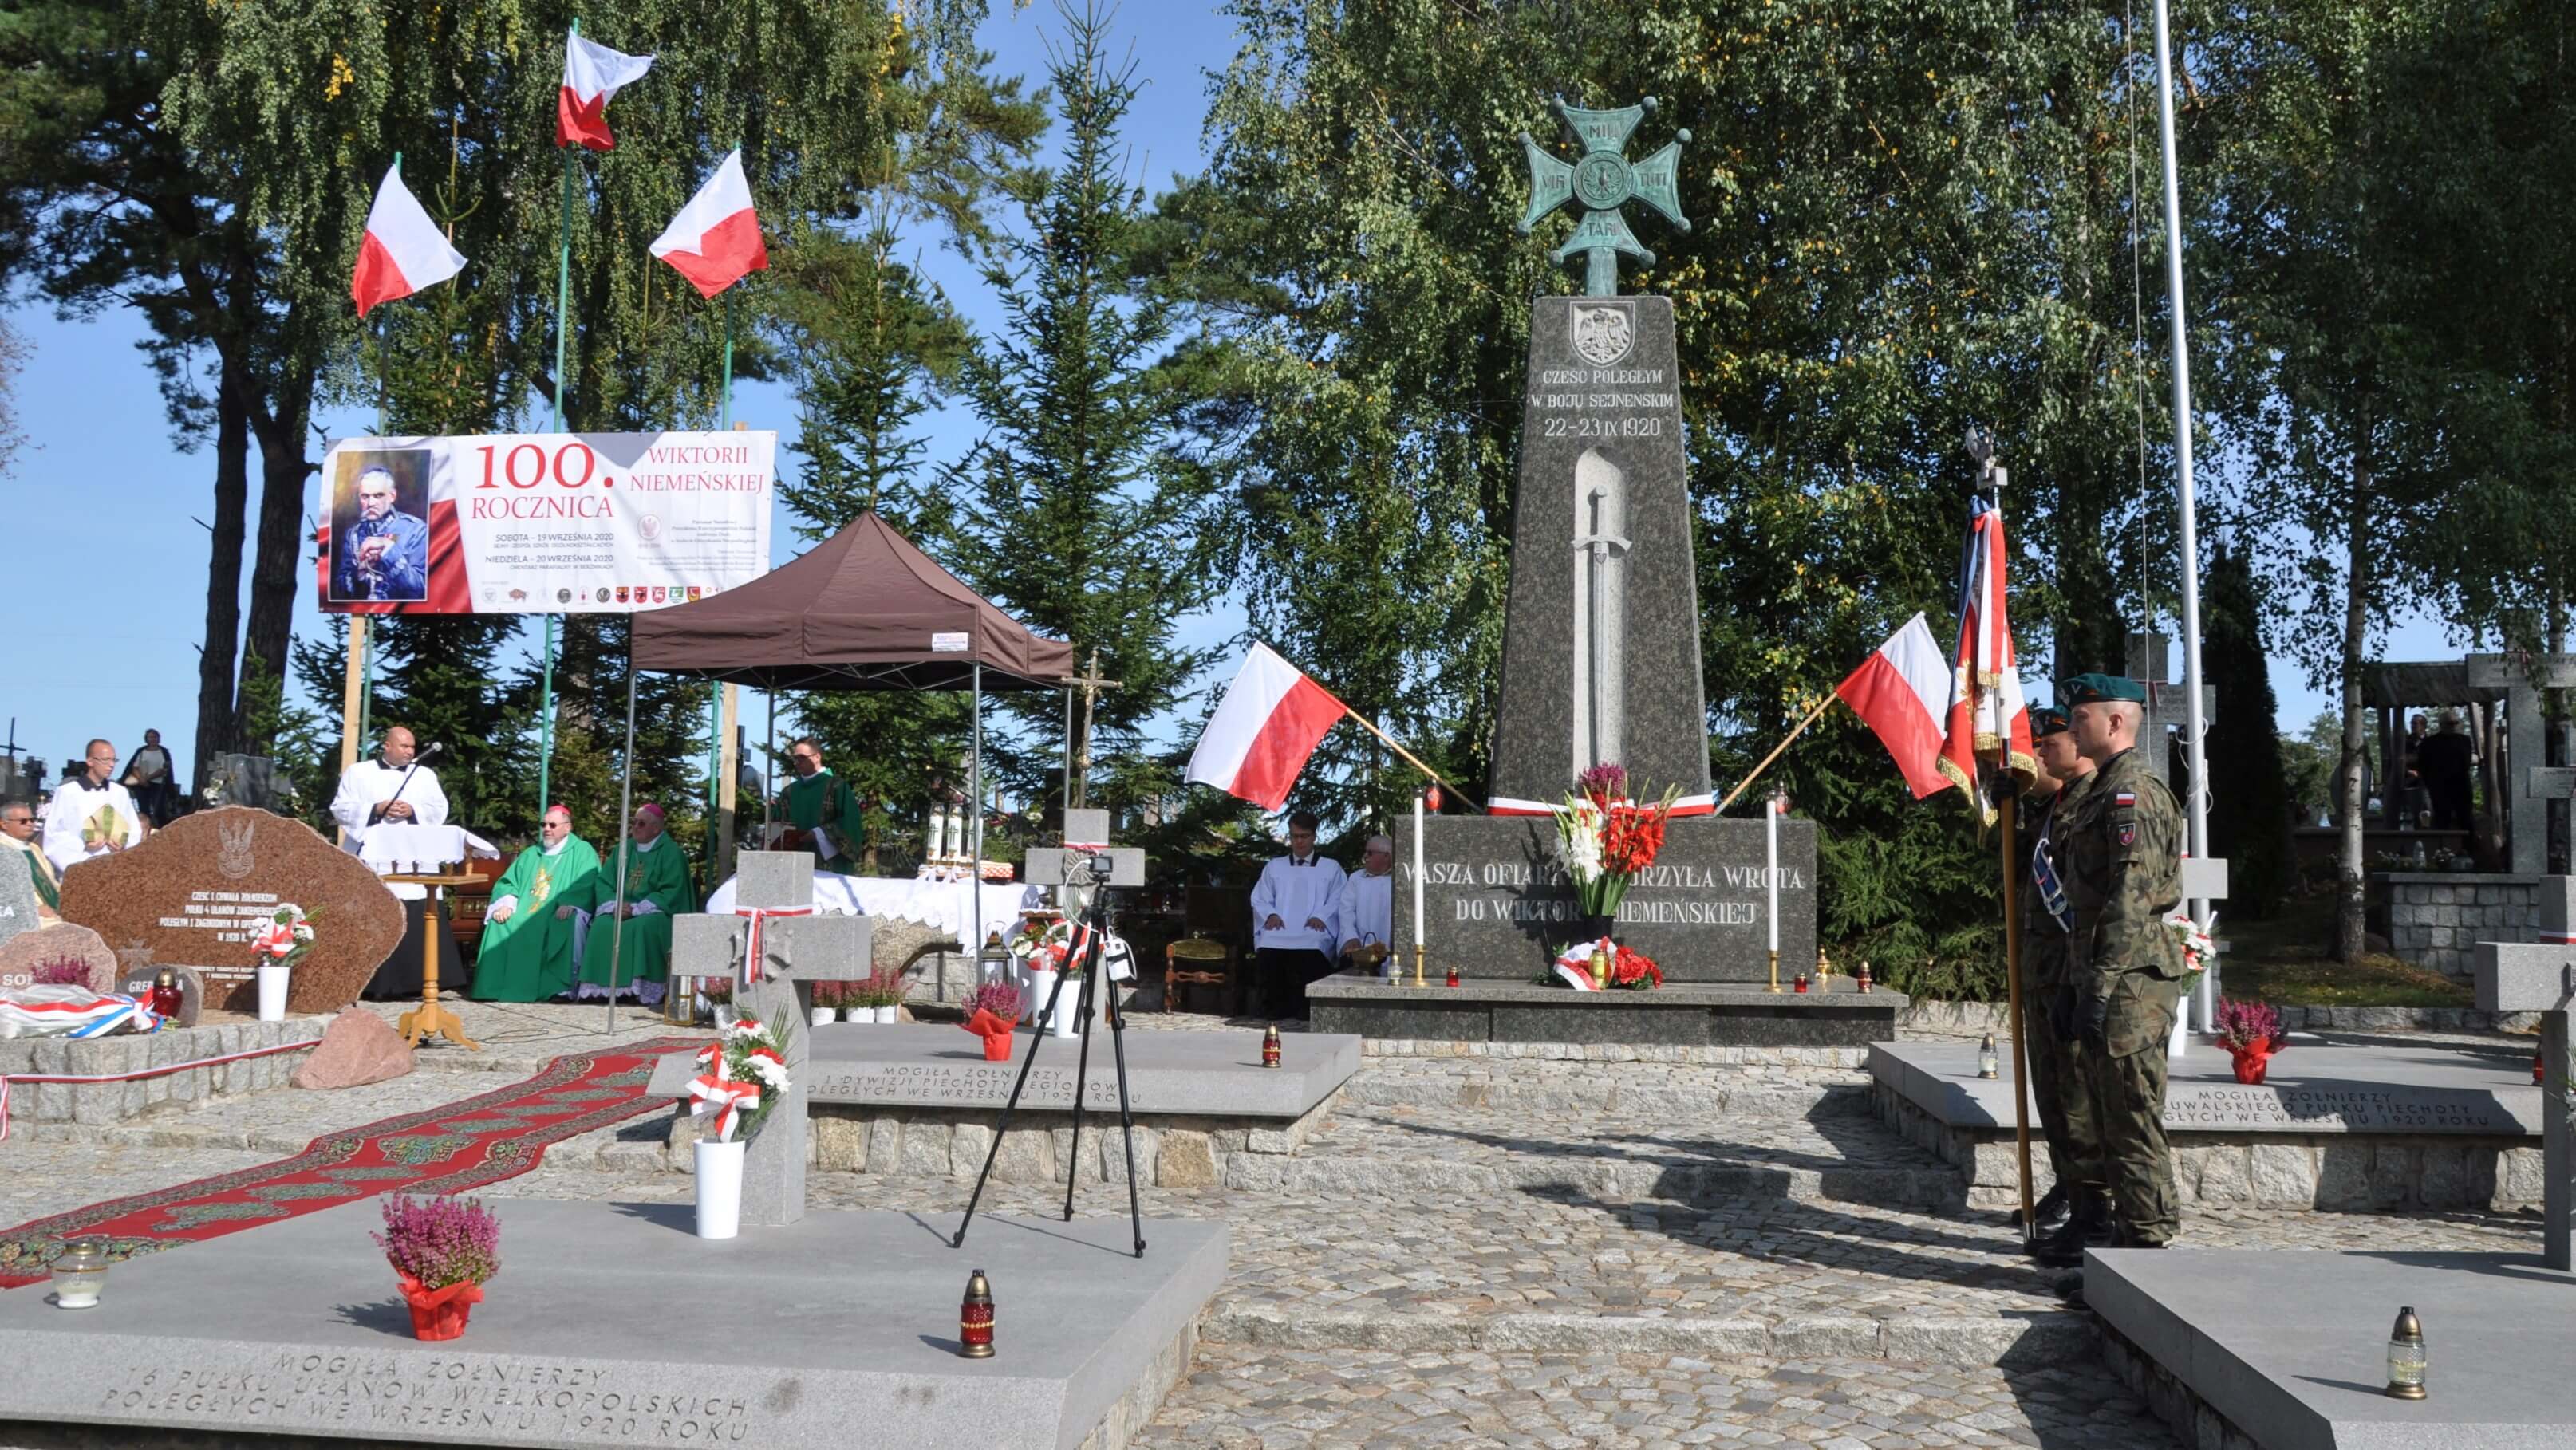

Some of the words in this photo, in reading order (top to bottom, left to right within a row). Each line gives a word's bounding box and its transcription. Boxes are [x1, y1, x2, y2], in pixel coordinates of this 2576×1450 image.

[1542, 175, 1565, 189] VIR
[1593, 369, 1663, 384] POLEGŁYM
[1531, 394, 1542, 408] W
[1548, 394, 1584, 408] BOJU
[1589, 391, 1674, 408] SEJNEŃSKIM
[1544, 417, 1600, 437] 22-23
[1604, 420, 1618, 436] IX
[1623, 417, 1661, 436] 1920
[475, 443, 614, 489] 100.
[649, 447, 748, 464] WIKTORII
[471, 496, 614, 519] ROCZNICA
[630, 470, 764, 494] NIEMEŃSKIEJ
[495, 534, 529, 542] SOBOTA
[548, 531, 593, 542] WRZEŚNIA
[594, 533, 613, 542] 2020
[547, 554, 592, 563] WRZEŚNIA
[1403, 862, 1476, 885] WASZA
[1629, 865, 1717, 887] RZYŁA
[1456, 899, 1484, 920] DO
[1492, 899, 1583, 922] WIKTOR
[882, 1066, 952, 1078] MOGIŁA
[842, 1075, 913, 1086] DYWIZJI
[922, 1078, 1011, 1088] PIECHOTY
[807, 1085, 897, 1096] OLEGŁYCH
[907, 1088, 932, 1097] WE
[1042, 1092, 1071, 1101] 192
[1094, 1093, 1142, 1104] ROU
[2199, 1090, 2274, 1101] MOGIŁA
[2170, 1101, 2294, 1112] UWALSKIEGO
[2377, 1104, 2471, 1115] PIECHOTY
[2163, 1111, 2226, 1122] GŁYCH
[2235, 1113, 2262, 1123] WE
[2382, 1114, 2427, 1125] 1920
[2437, 1115, 2490, 1126] ROKU
[272, 1353, 398, 1376] MOGIŁA
[124, 1366, 158, 1386] 16
[177, 1369, 278, 1392] PUŁKU
[452, 1385, 748, 1417] WIELKOPOLSKICH
[101, 1388, 294, 1417] POLEGŁYCH
[310, 1401, 352, 1420] WE
[559, 1414, 637, 1436] 1920
[658, 1419, 749, 1441] ROKU
